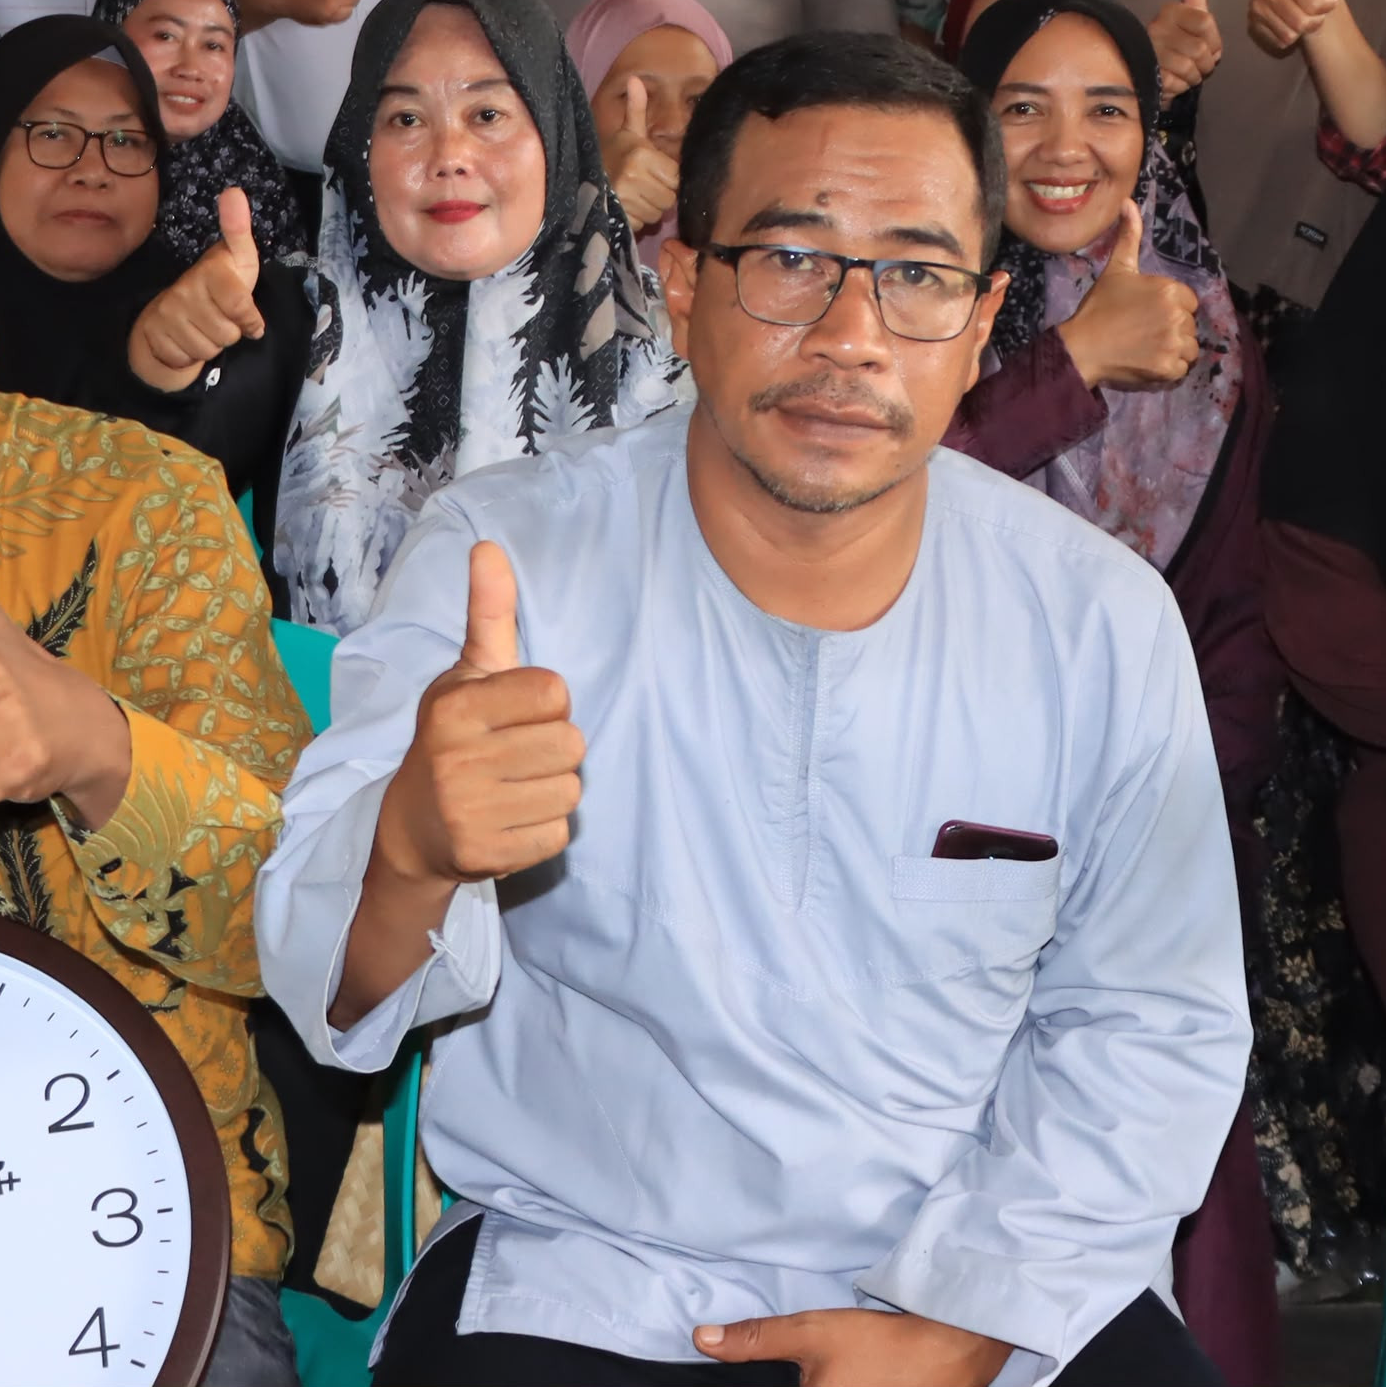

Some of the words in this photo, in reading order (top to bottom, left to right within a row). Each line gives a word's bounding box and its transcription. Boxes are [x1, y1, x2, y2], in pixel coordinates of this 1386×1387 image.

[43, 1072, 95, 1134] 2
[90, 1186, 145, 1248] 3
[67, 1306, 120, 1369] 4
